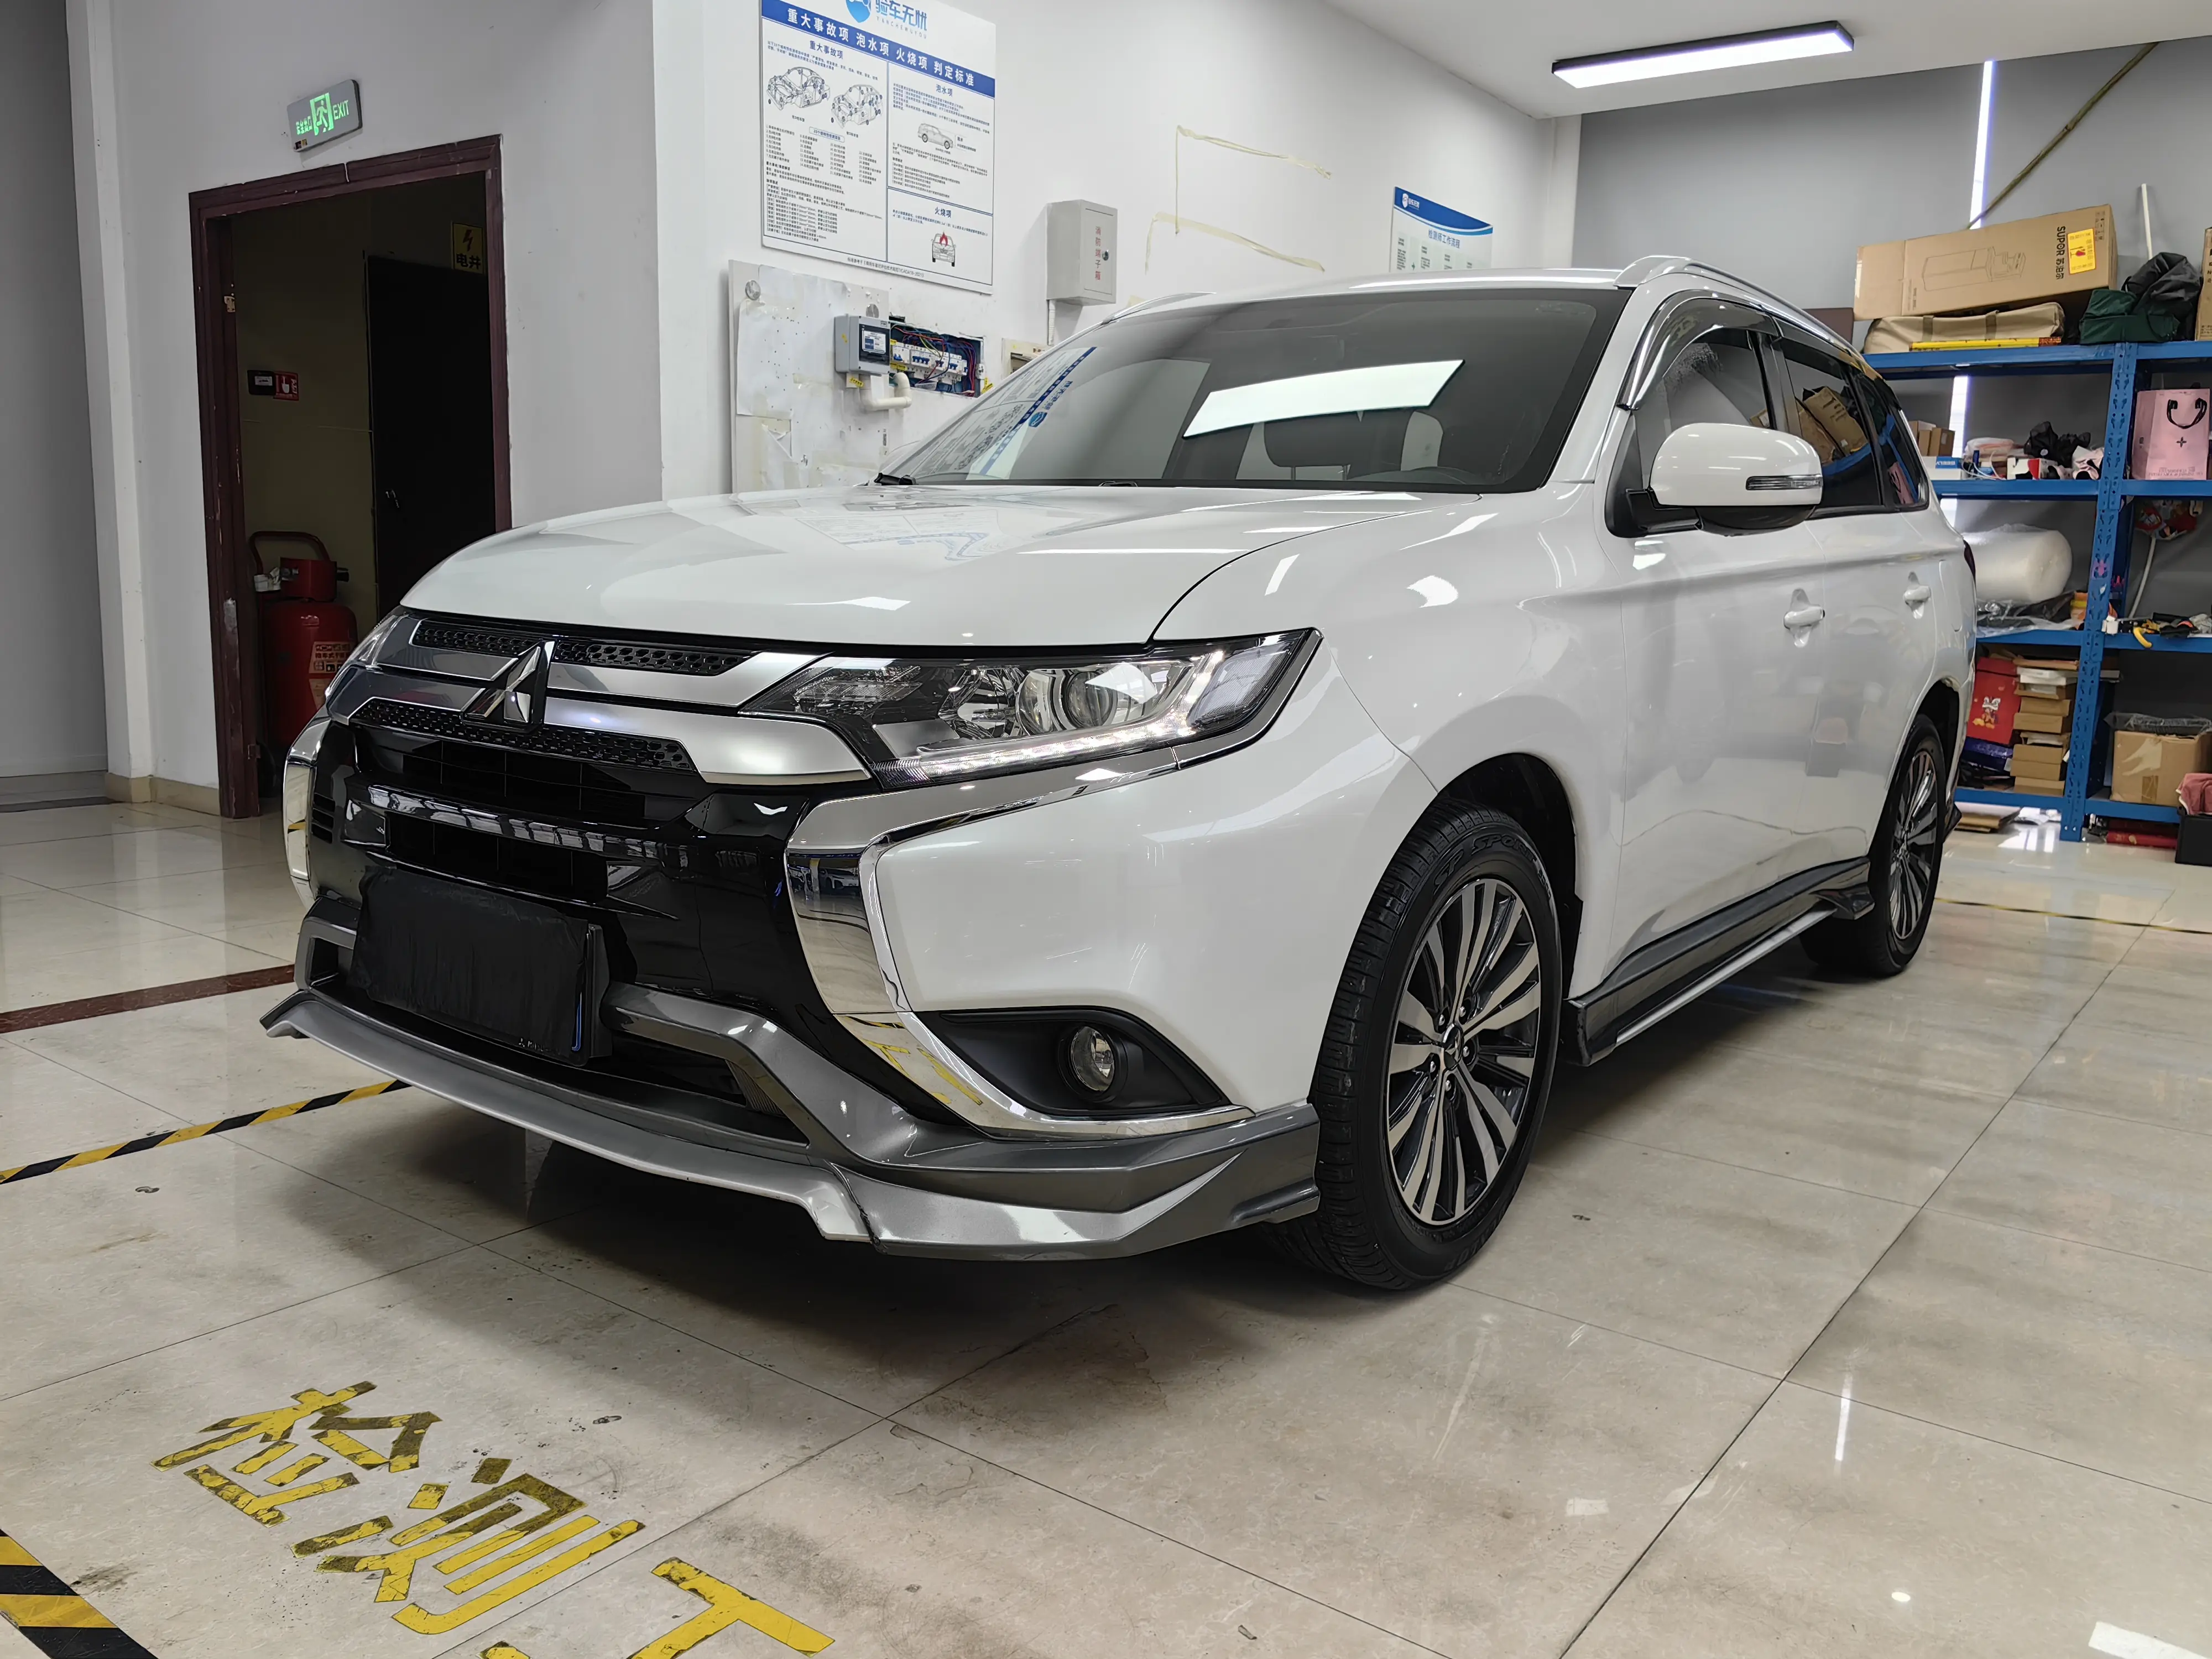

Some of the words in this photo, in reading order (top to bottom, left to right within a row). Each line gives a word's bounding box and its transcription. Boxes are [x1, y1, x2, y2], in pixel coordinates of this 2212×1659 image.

[787, 8, 848, 42] 重大事故项
[856, 33, 889, 56] 泡水项
[896, 48, 927, 70] 火烧项
[933, 61, 974, 86] 判定标准
[810, 40, 843, 59] 重大事故项
[936, 84, 953, 97] 泡水项
[332, 100, 348, 120] EXIT
[935, 206, 952, 218] 火烧项
[2056, 226, 2066, 256] SUPOR
[1433, 849, 1464, 896] SP
[1472, 833, 1537, 862] SPORT
